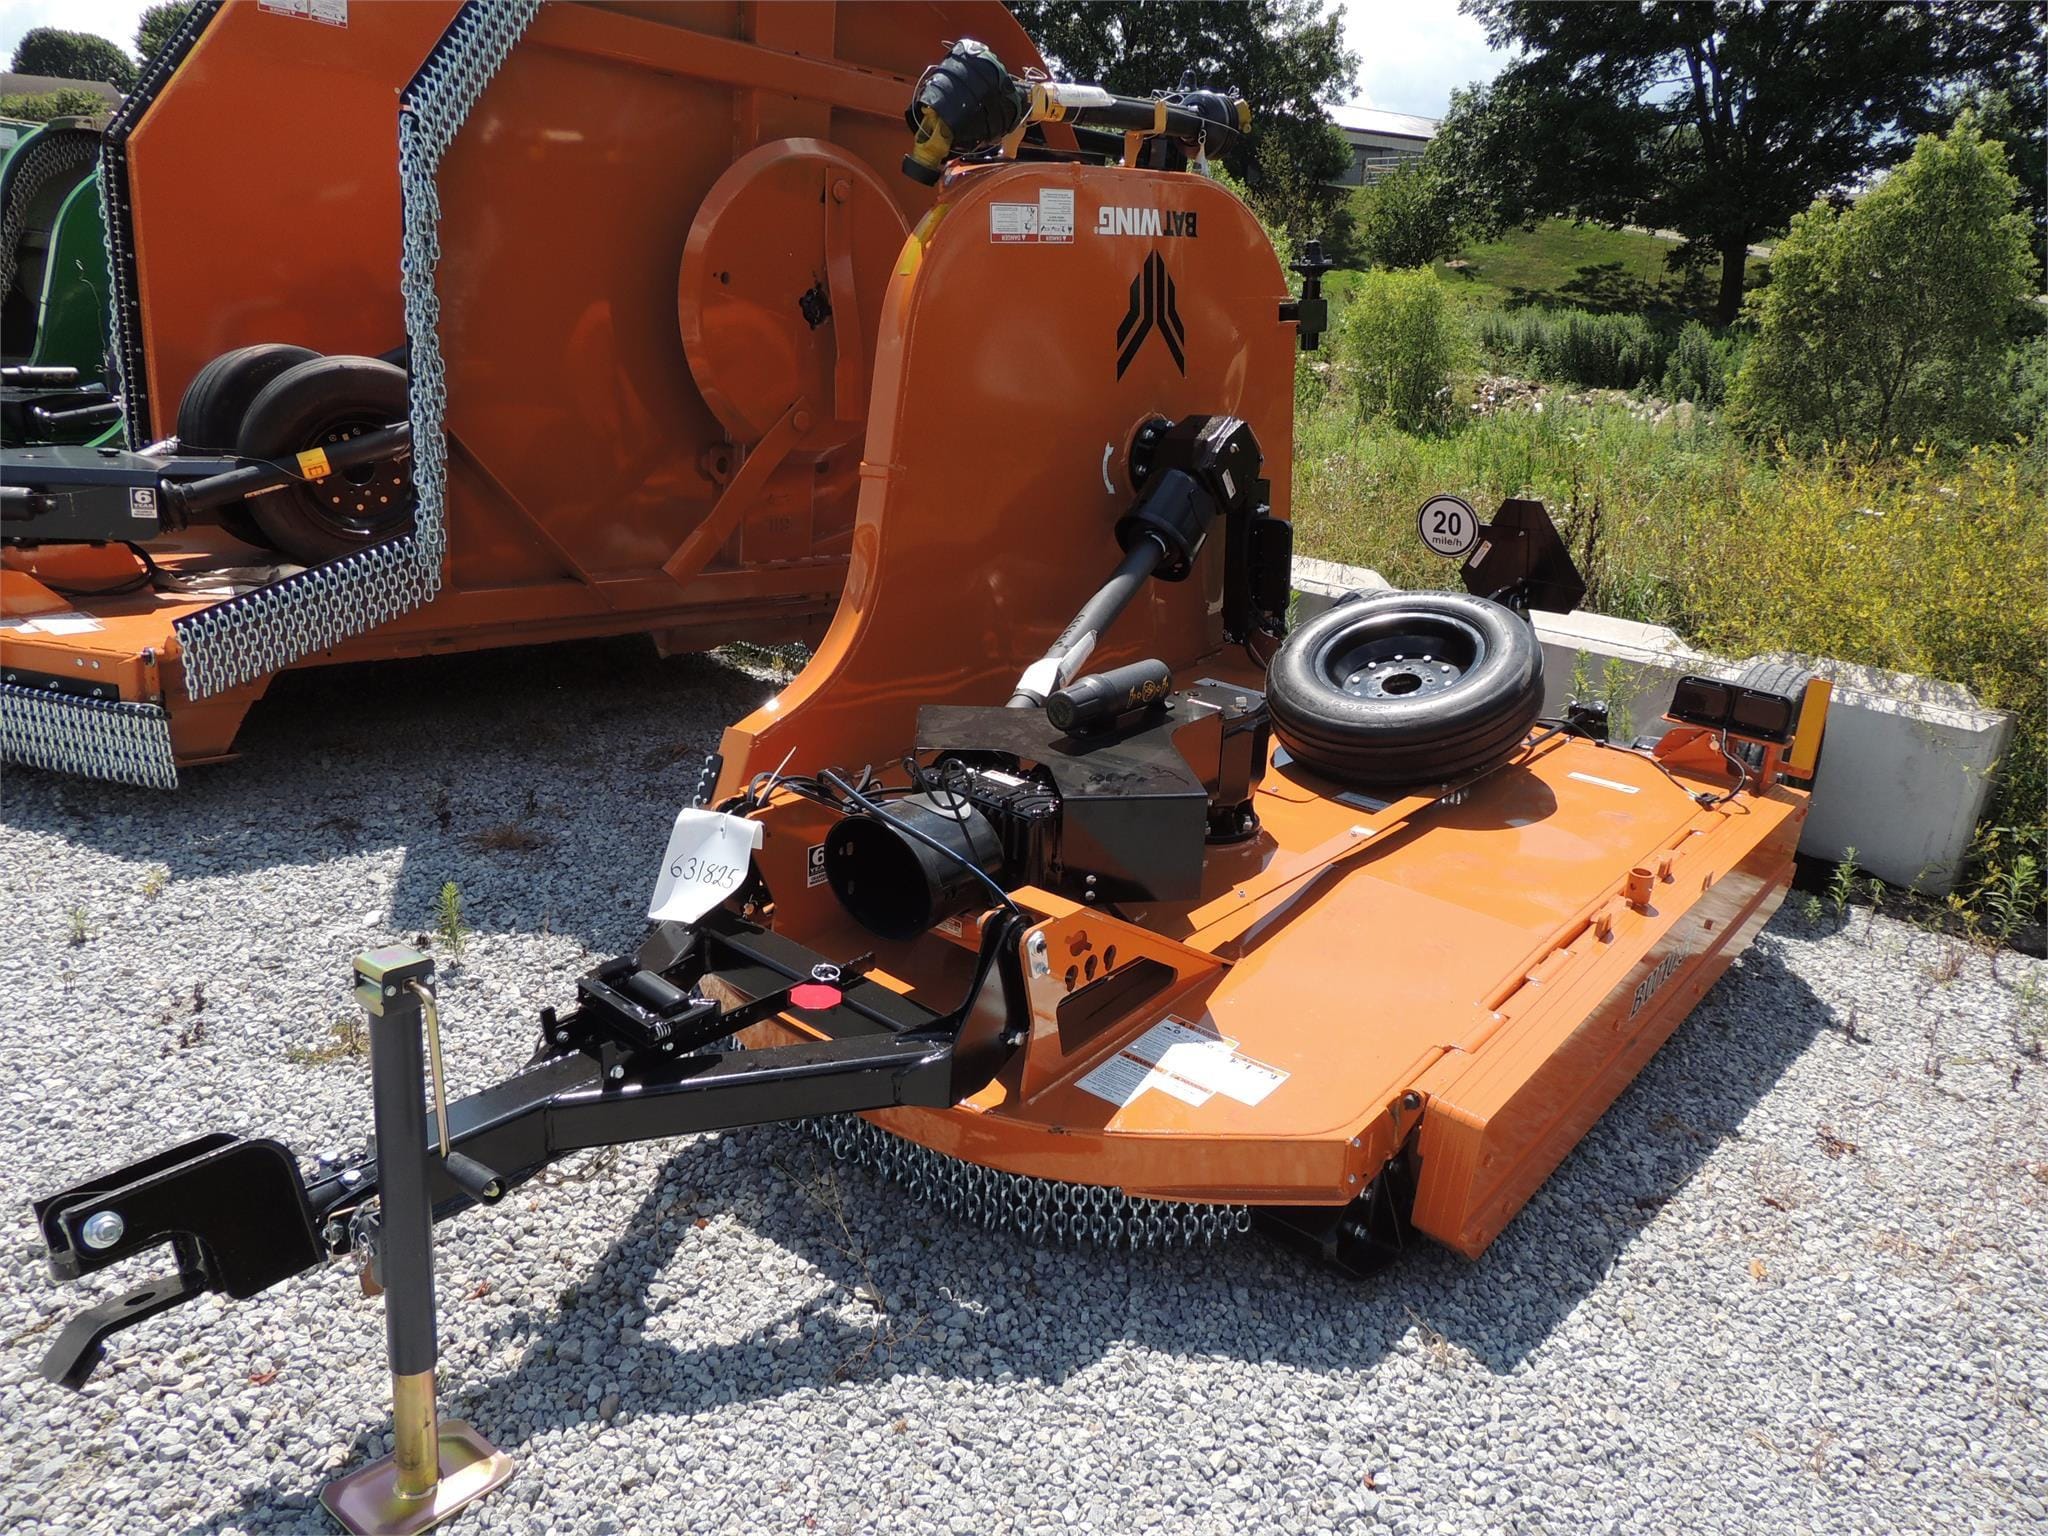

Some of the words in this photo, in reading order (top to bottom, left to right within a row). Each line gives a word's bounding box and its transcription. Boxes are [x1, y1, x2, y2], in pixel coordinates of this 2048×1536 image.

[134, 490, 152, 504] 6
[1433, 510, 1462, 536] 20
[1432, 536, 1463, 547] mile/h
[812, 846, 825, 866] 6
[670, 853, 740, 890] 631825
